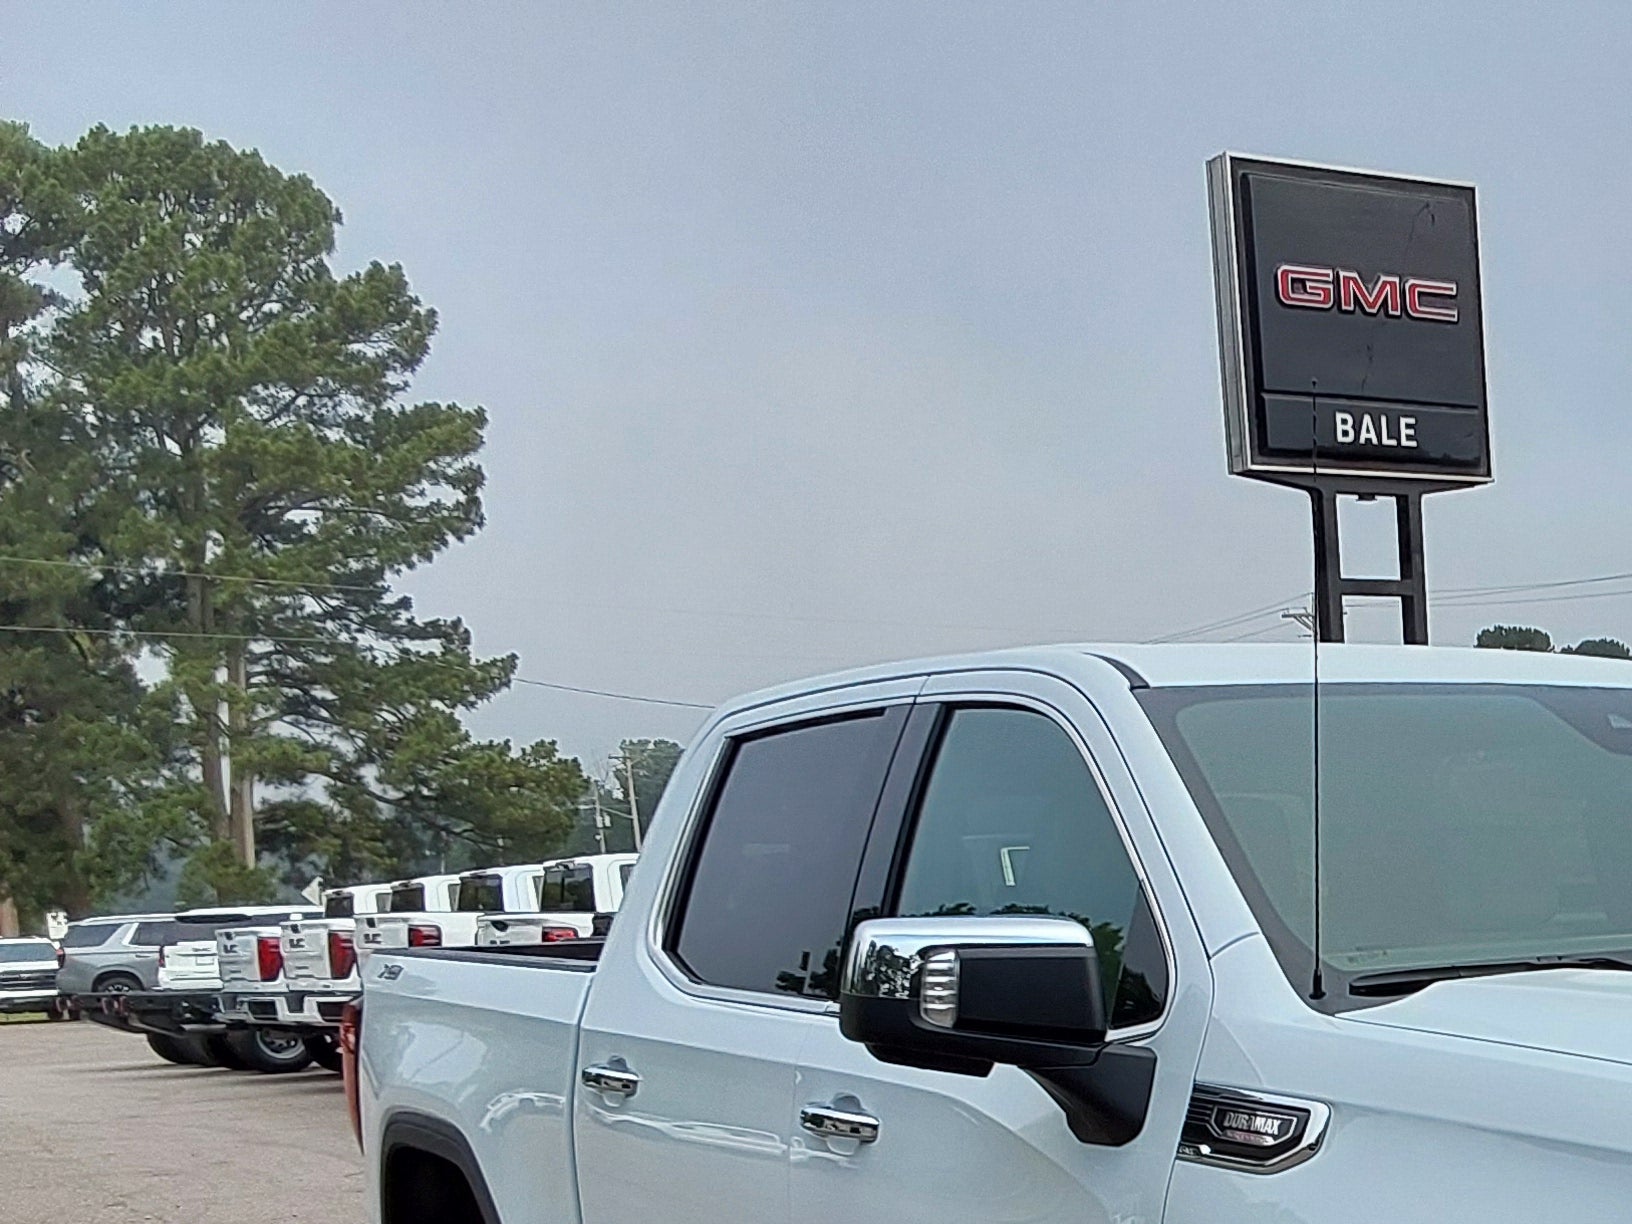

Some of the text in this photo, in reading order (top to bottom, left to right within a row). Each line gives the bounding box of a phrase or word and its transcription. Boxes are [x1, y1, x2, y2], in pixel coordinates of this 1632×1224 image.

[1275, 264, 1459, 323] GMC
[1335, 411, 1418, 448] BALE
[1223, 1112, 1282, 1135] DURAMAX
